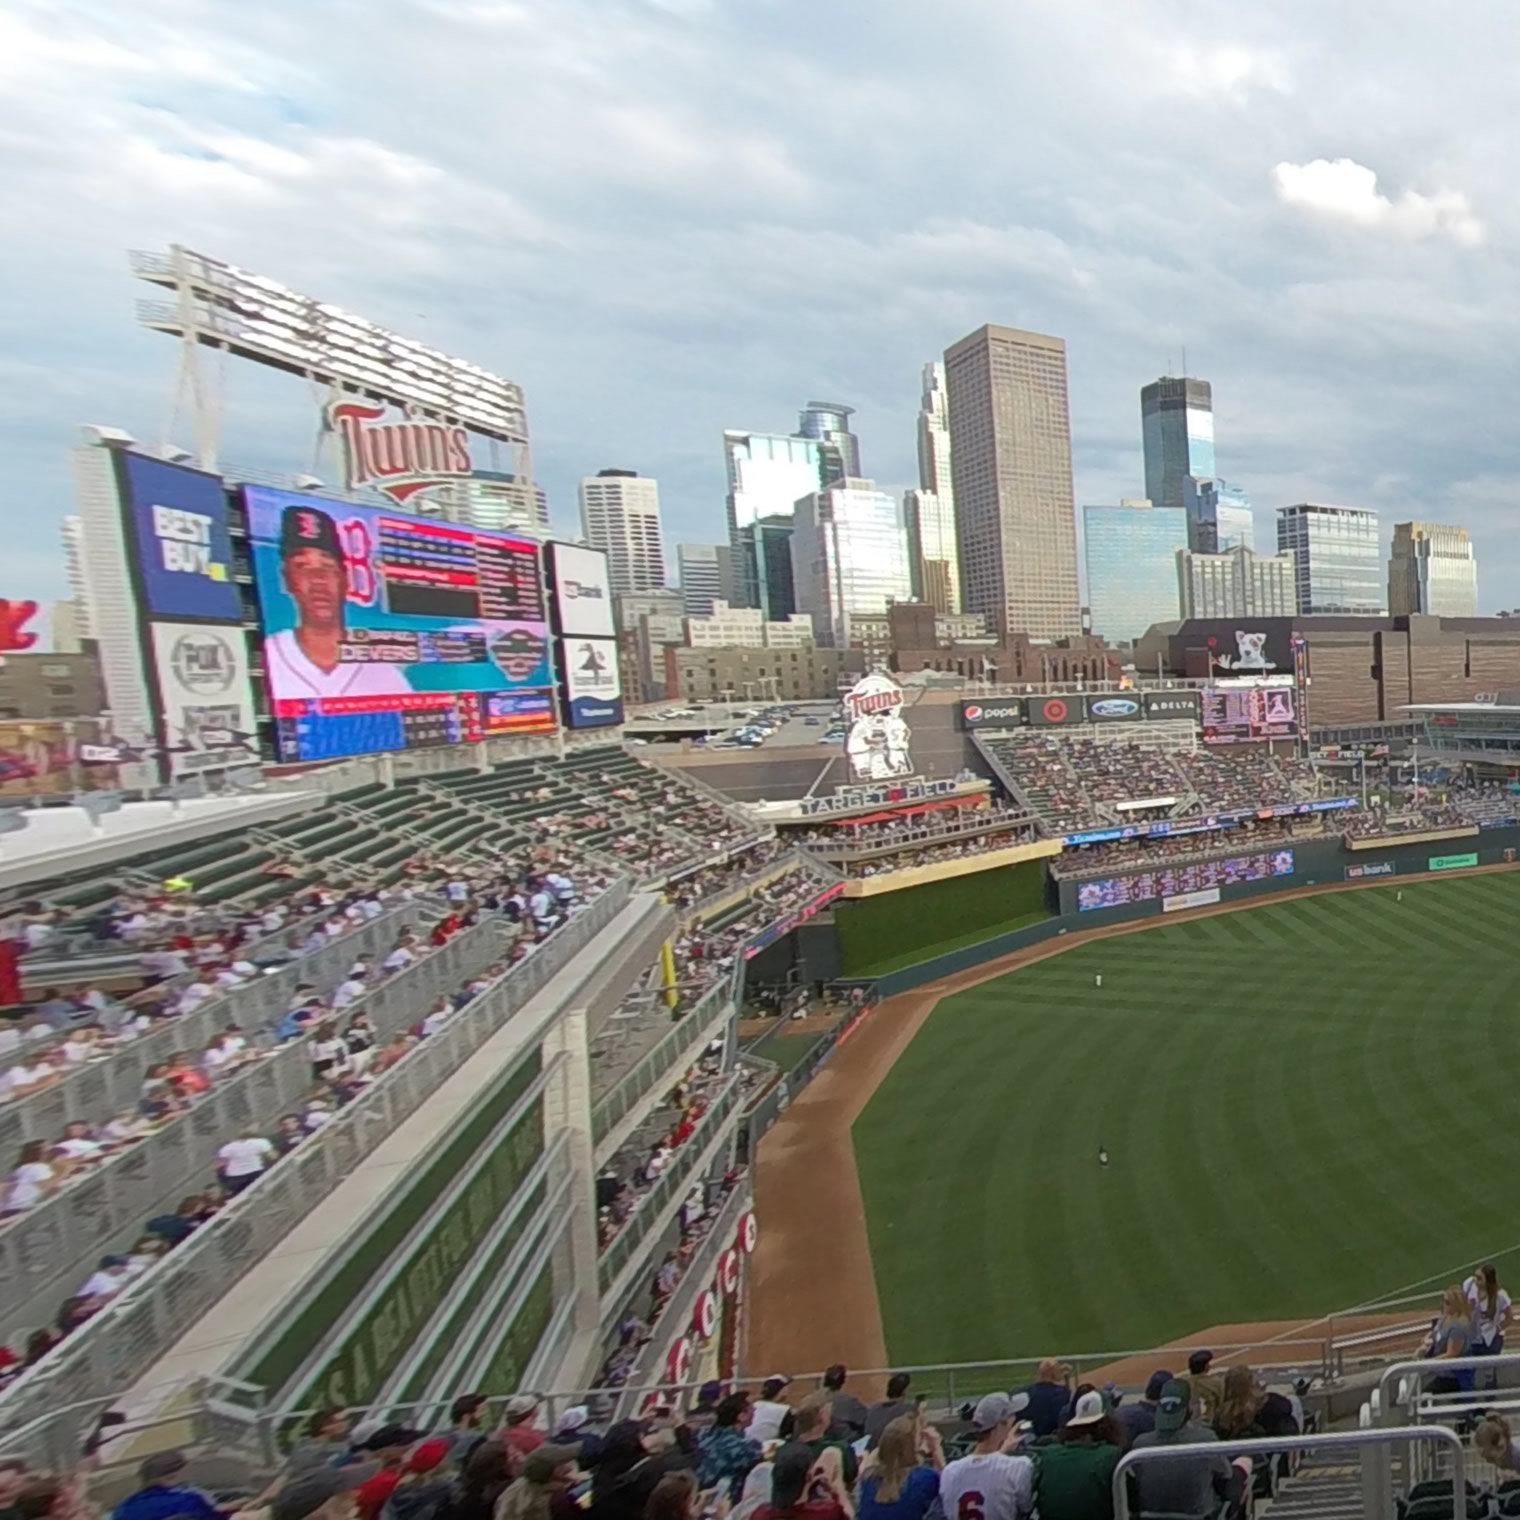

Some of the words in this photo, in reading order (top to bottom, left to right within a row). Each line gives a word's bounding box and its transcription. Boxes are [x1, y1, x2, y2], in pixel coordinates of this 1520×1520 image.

[329, 402, 474, 486] Twins
[152, 504, 213, 544] BEST
[162, 540, 211, 576] BUY
[340, 644, 418, 661] DEVERS
[849, 690, 902, 720] Twins
[984, 704, 1018, 719] pepsi
[1160, 700, 1195, 710] DELTA
[800, 792, 886, 814] TARGET
[903, 780, 958, 801] FIELD
[1349, 867, 1363, 877] us
[1363, 862, 1392, 876] bank
[958, 1491, 985, 1520] 6
